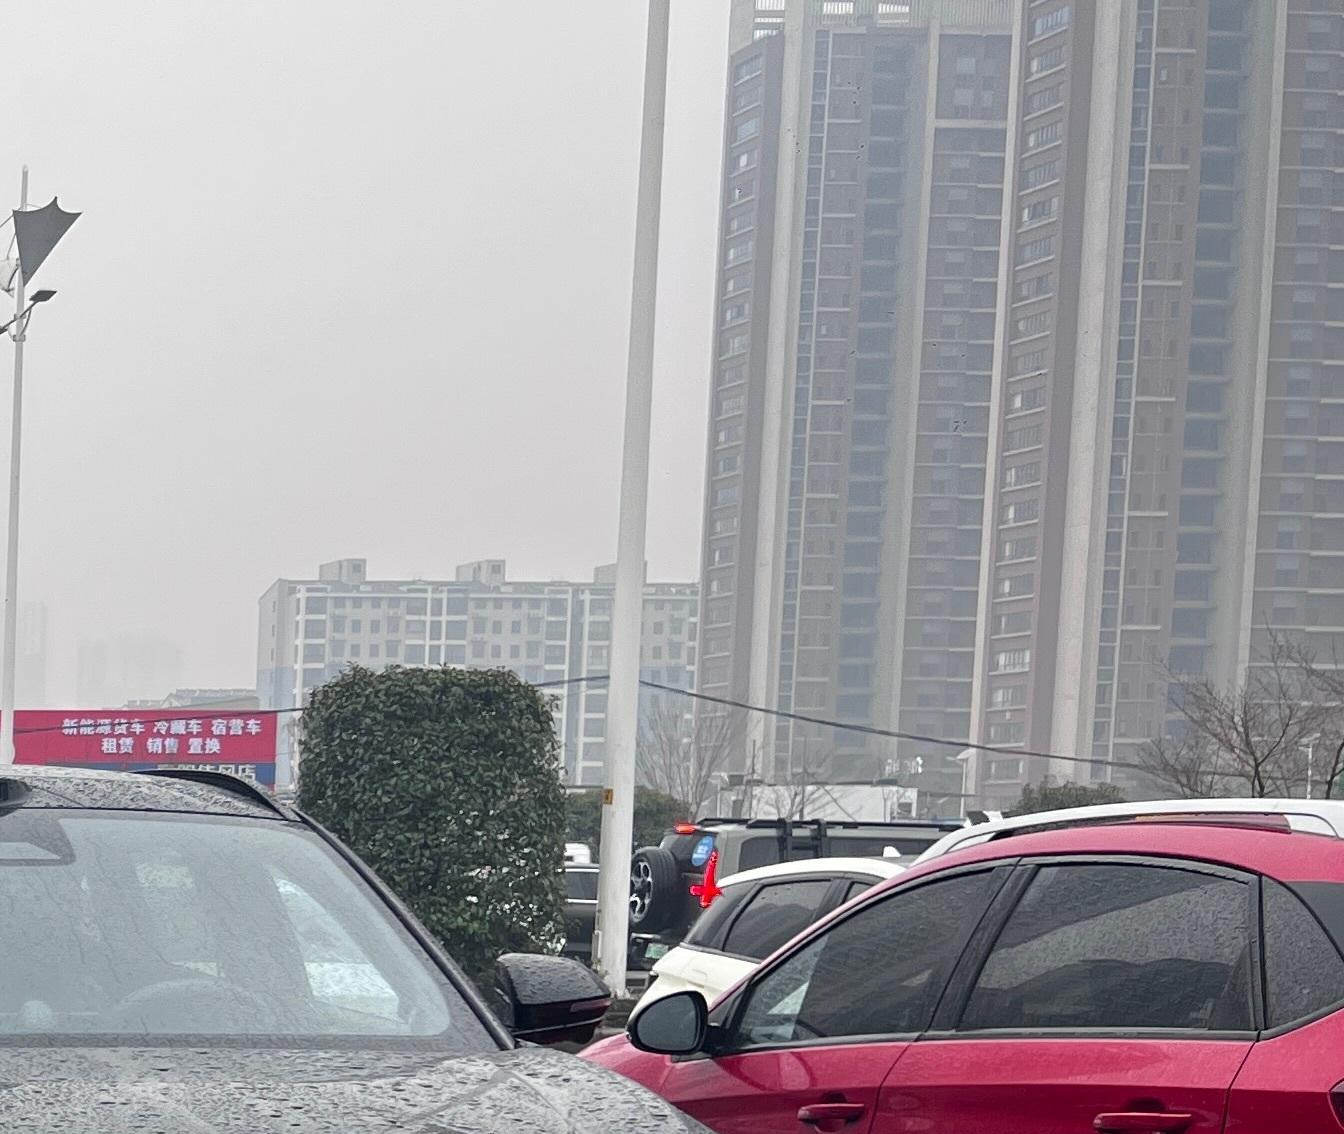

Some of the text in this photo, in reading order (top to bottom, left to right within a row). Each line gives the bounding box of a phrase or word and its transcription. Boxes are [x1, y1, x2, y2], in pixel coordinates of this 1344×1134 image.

[62, 718, 262, 736] 新能源货车 冷藏车 宿营车
[101, 737, 221, 754] 租赁 销售 置换
